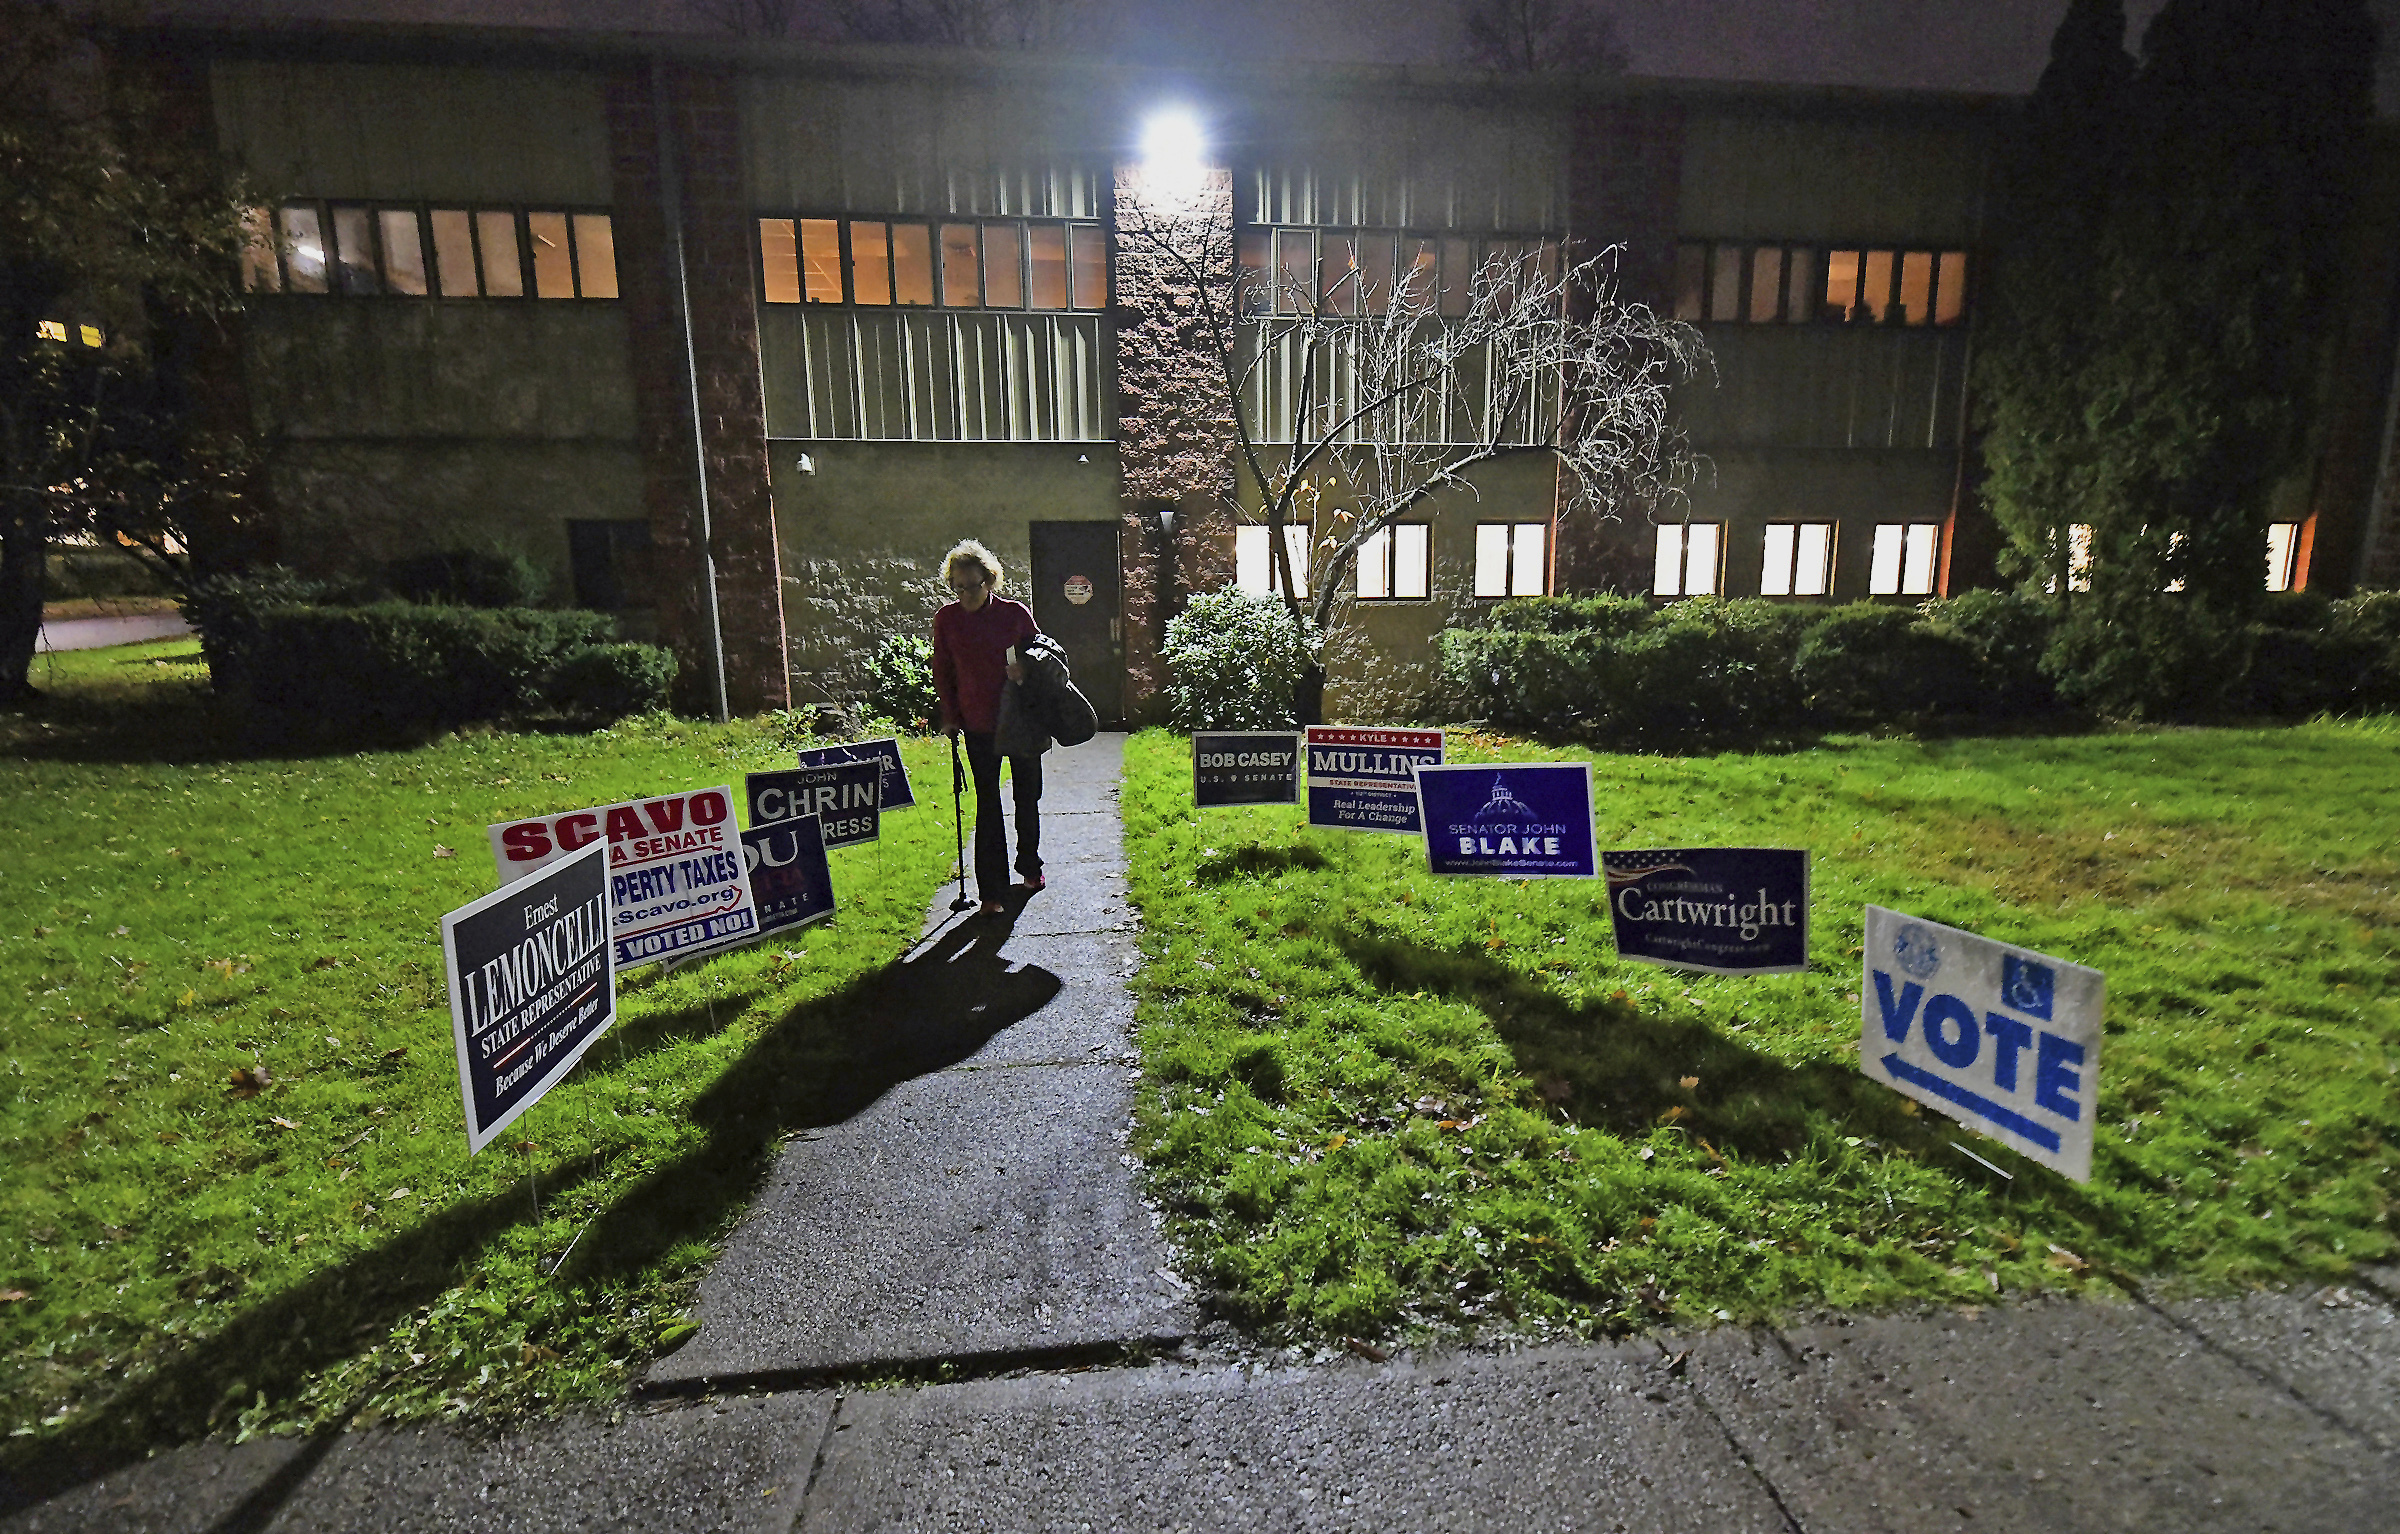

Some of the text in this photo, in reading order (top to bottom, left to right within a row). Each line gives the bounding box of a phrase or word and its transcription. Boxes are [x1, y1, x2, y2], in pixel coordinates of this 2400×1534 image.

[1360, 733, 1387, 743] KYLE
[1200, 752, 1292, 767] BOB CASEY
[797, 771, 837, 785] JOHN
[1200, 774, 1292, 783] U.S. SENATE
[1354, 781, 1417, 790] REPRESENTATIV
[757, 782, 874, 820] CHRIN
[1334, 800, 1415, 815] Real Leadership
[1339, 811, 1407, 824] For A Change
[502, 792, 727, 861] SCAVO
[635, 826, 723, 858] SENATE
[1449, 824, 1566, 834] SENATOR JOHN
[1459, 837, 1561, 855] BLAKE
[679, 850, 738, 890] TAXES
[524, 894, 559, 930] Ernest
[1618, 888, 1796, 941] Cartwright
[626, 925, 707, 959] VOTED
[709, 910, 750, 937] NO!
[464, 893, 606, 1038] LEMONCELLI
[481, 953, 601, 1059] STATE REPRESENTATIVE
[495, 998, 599, 1098] Because We Deserve Better
[1873, 969, 2086, 1122] VOTE
